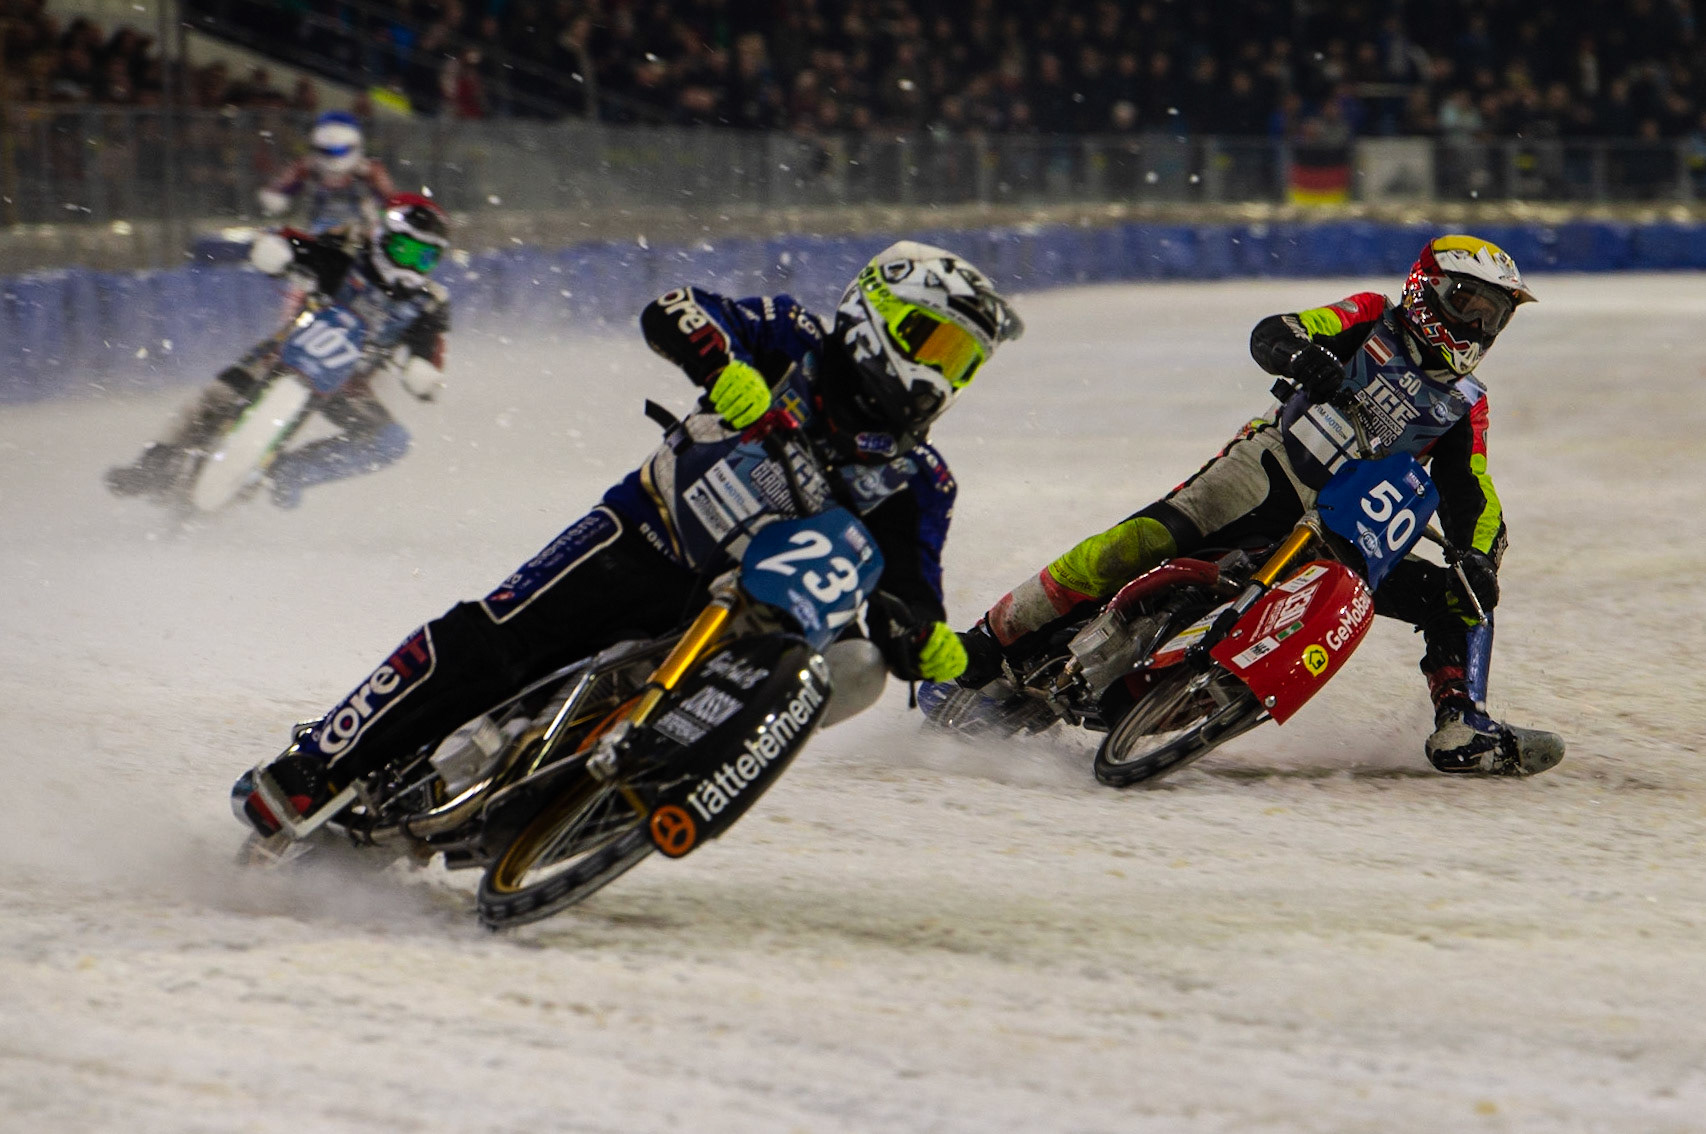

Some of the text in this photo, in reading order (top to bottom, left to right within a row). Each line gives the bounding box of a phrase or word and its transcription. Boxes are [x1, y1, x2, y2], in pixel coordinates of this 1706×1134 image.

[292, 320, 362, 369] 107
[658, 288, 728, 357] oreIT
[1363, 376, 1418, 429] ICE
[1399, 371, 1422, 396] 50
[1361, 480, 1416, 552] 50
[319, 633, 428, 755] coreIT
